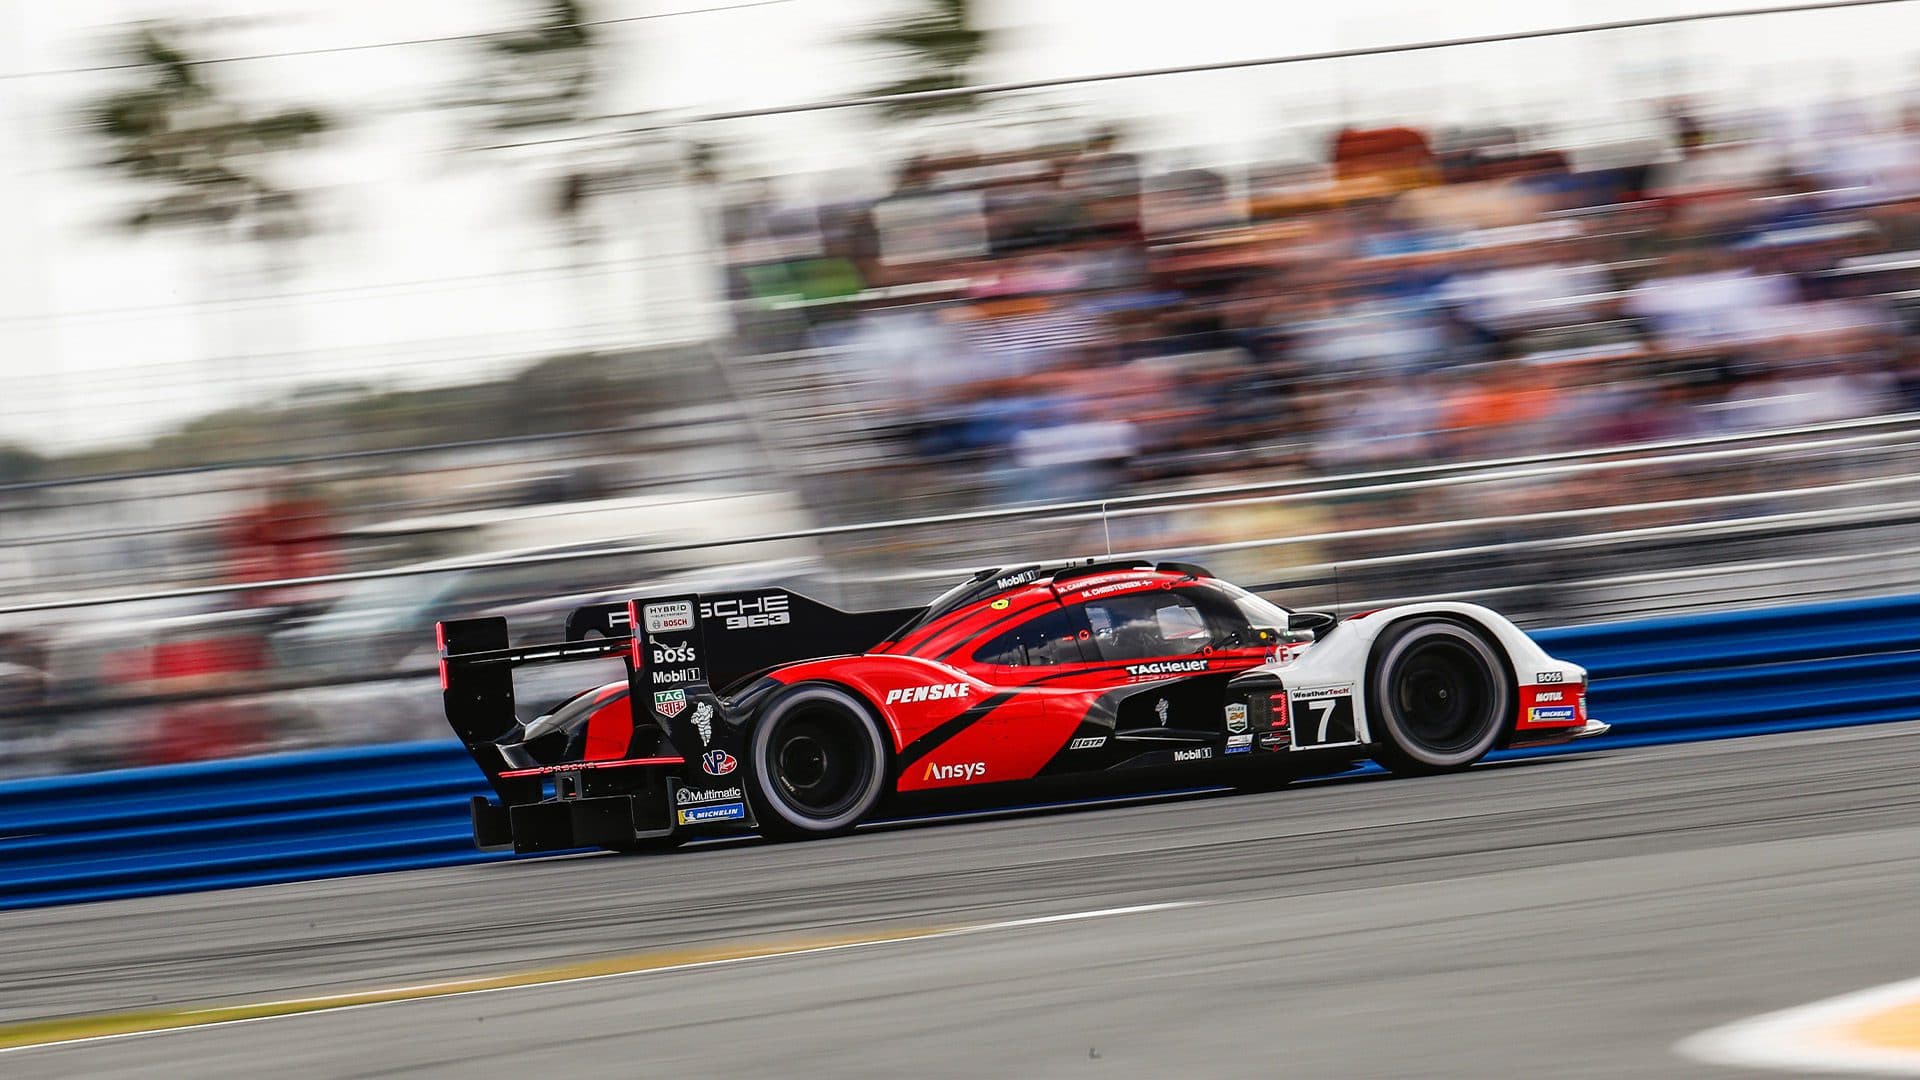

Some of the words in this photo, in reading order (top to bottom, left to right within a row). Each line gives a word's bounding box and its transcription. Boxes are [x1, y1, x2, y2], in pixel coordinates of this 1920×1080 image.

[997, 573, 1025, 589] Mobil
[650, 604, 687, 614] HYBRID
[663, 618, 688, 627] BOSCH
[726, 612, 790, 629] 963
[653, 647, 696, 664] BOSS
[653, 669, 687, 684] Mobil
[1537, 672, 1562, 682] BOSS
[657, 692, 683, 702] TAG
[885, 683, 970, 705] PENSKE
[1536, 691, 1563, 702] MOTUL
[657, 701, 686, 716] HEUER
[1269, 692, 1287, 727] 3
[1308, 700, 1336, 742] 7
[703, 749, 727, 775] VP
[1174, 748, 1201, 761] Mobil
[923, 762, 986, 781] Ansys
[691, 787, 741, 801] Multimatic
[696, 808, 738, 819] MICHELIN
